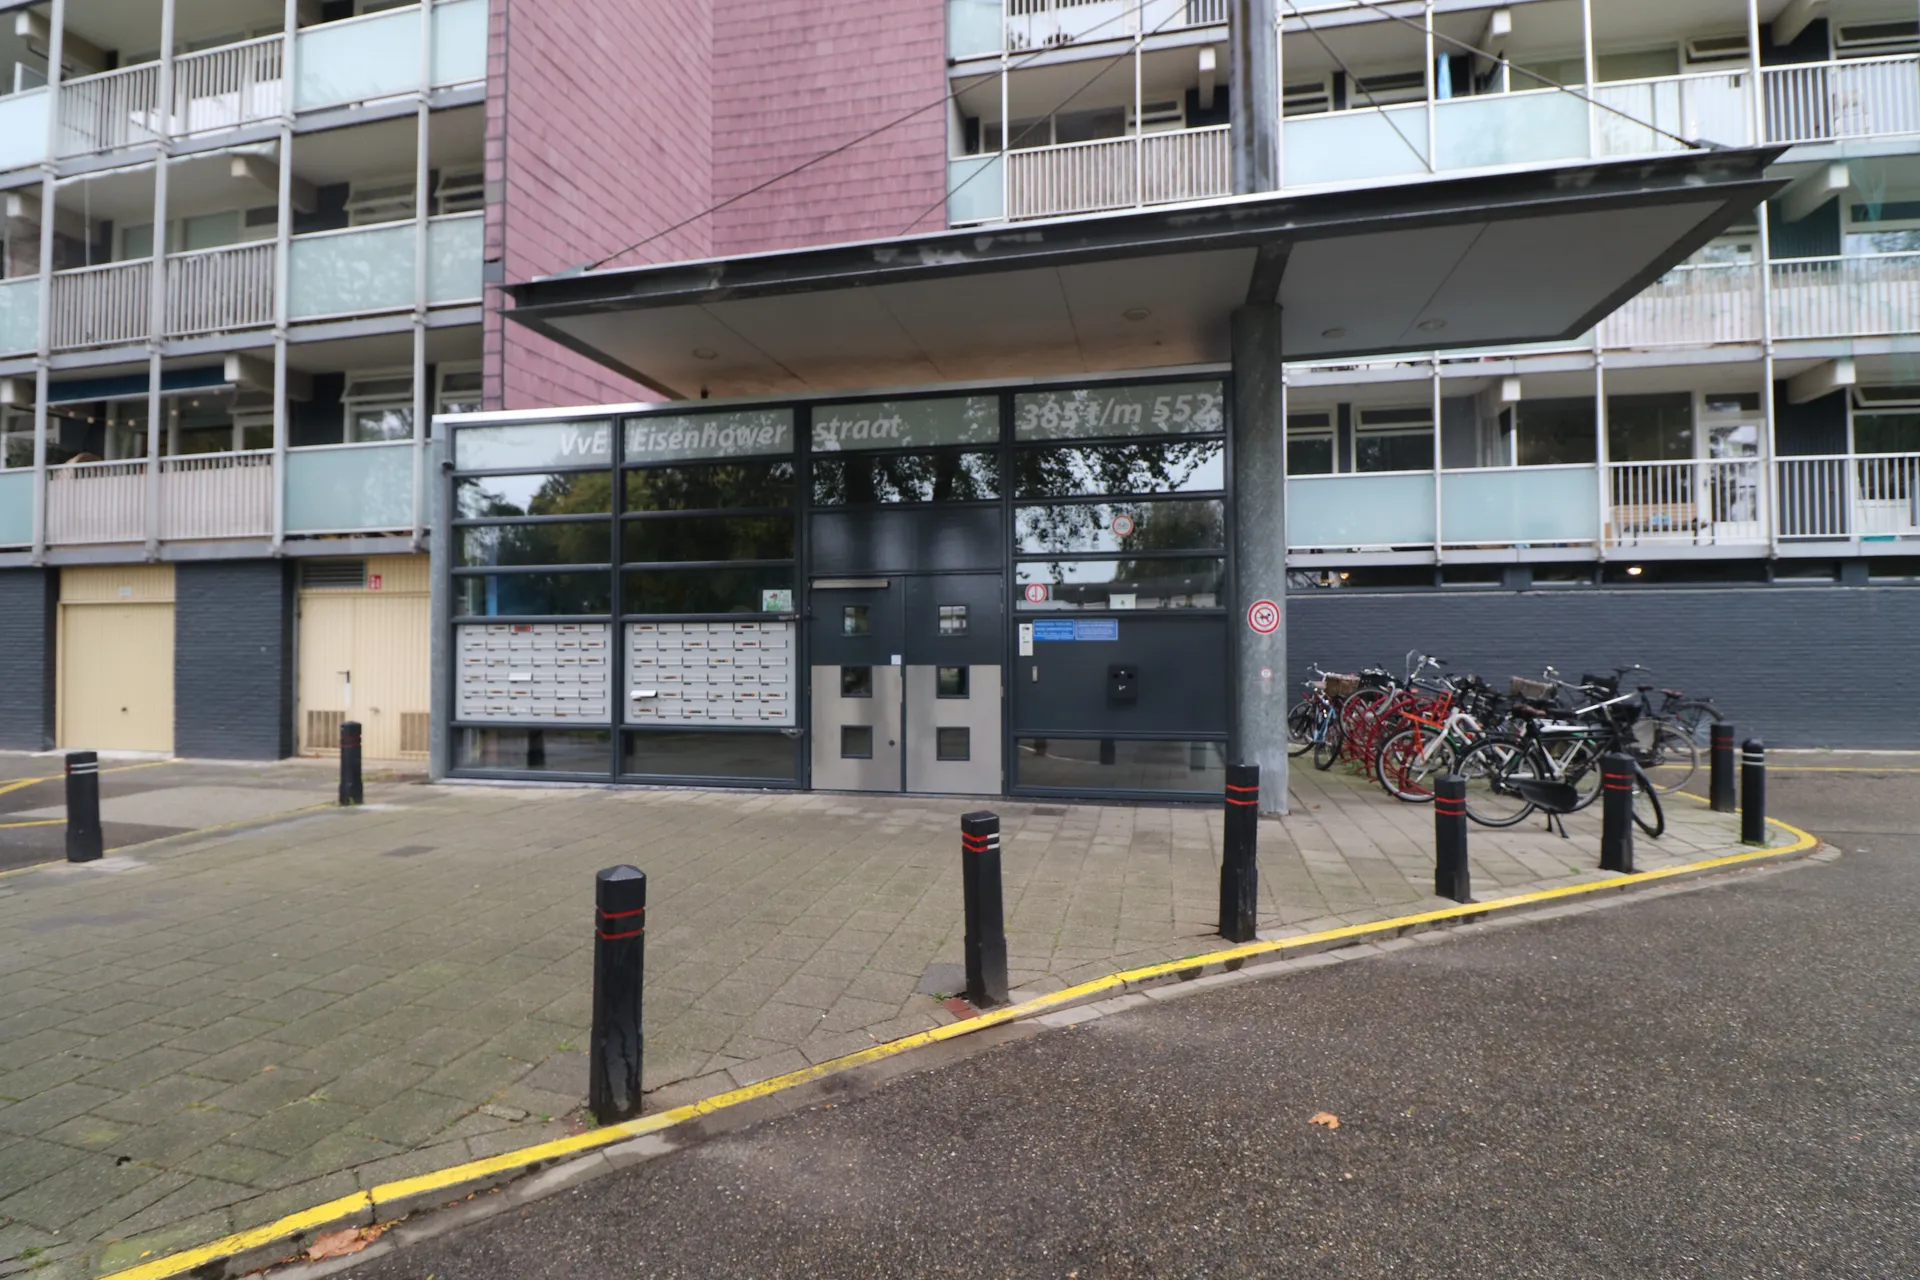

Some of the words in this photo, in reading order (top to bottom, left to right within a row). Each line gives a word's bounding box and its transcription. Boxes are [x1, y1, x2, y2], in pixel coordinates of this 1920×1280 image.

[561, 430, 608, 456] VvE
[633, 422, 787, 452] Eisenhower
[813, 413, 902, 442] straat
[1086, 397, 1142, 426] t/m
[1152, 393, 1214, 423] 552
